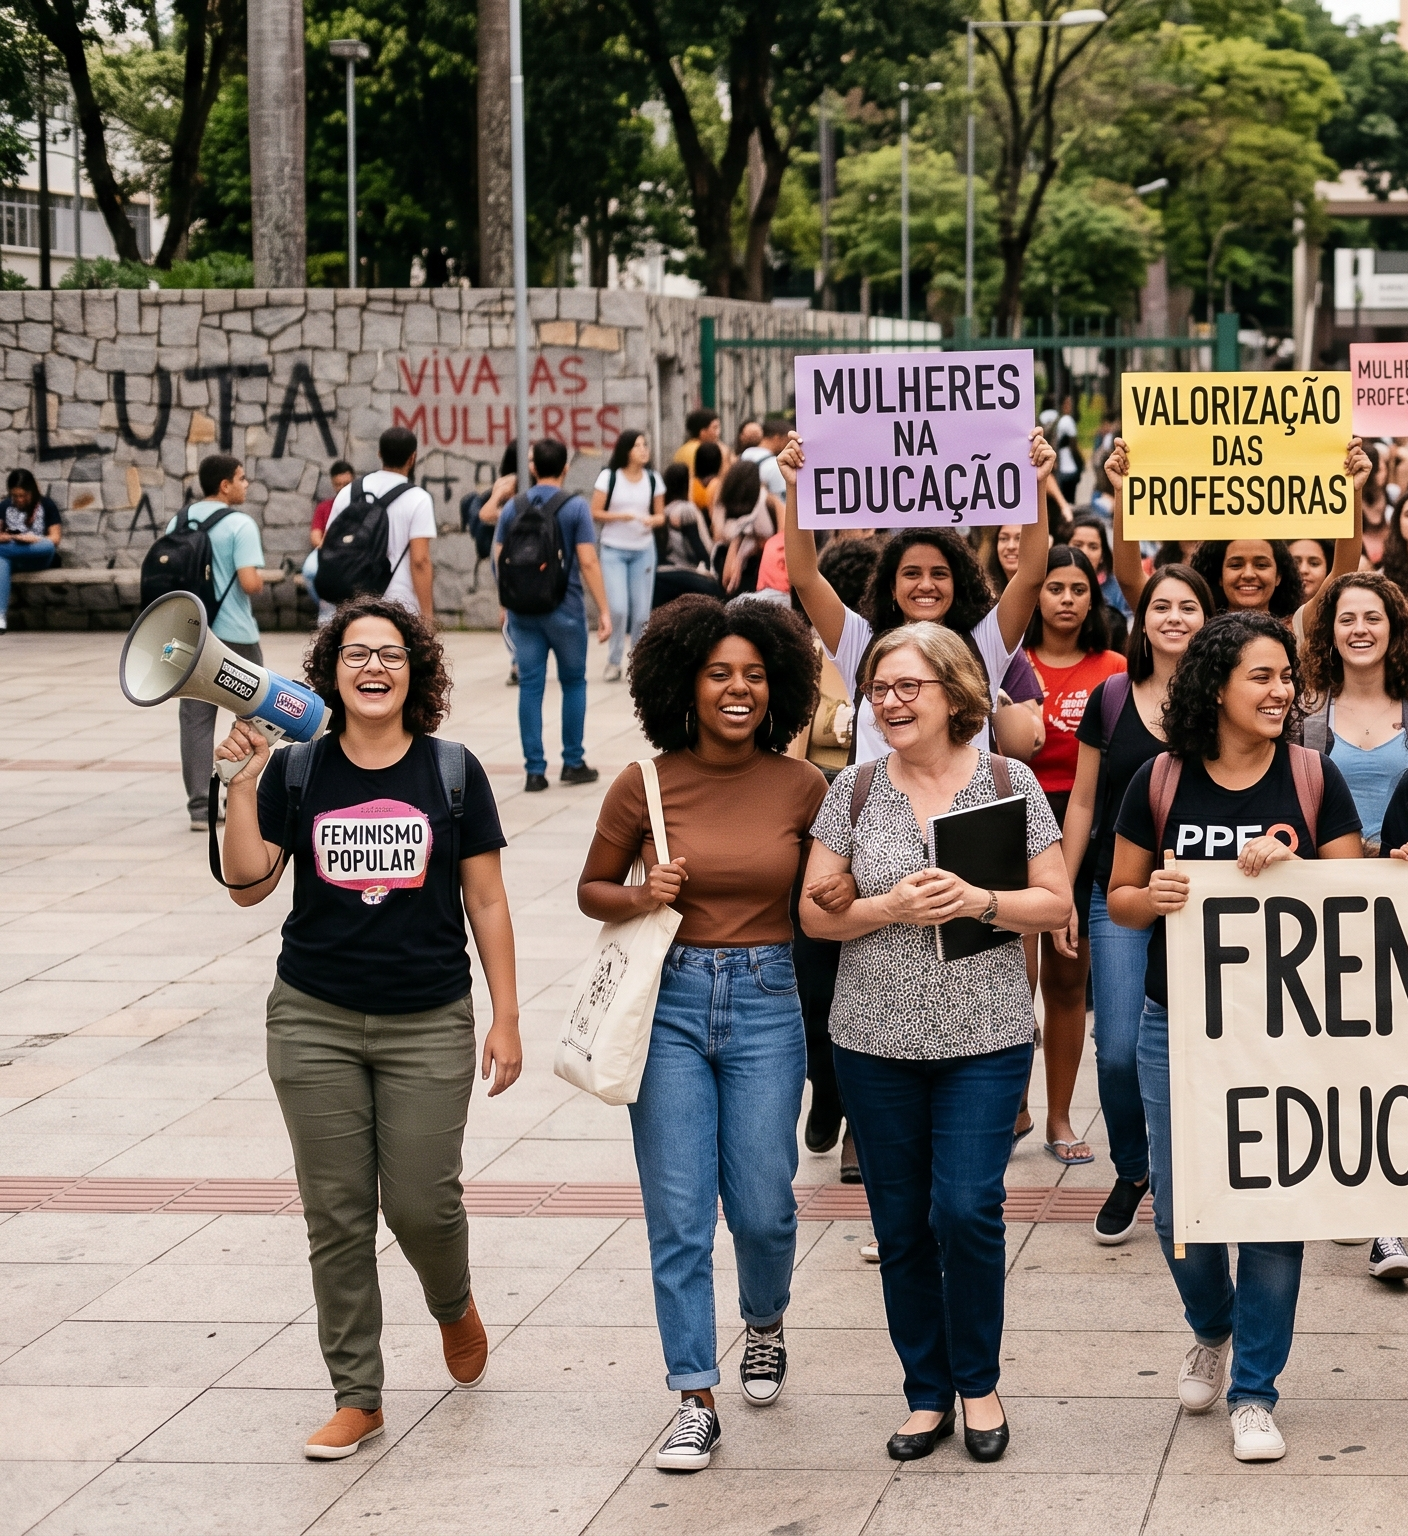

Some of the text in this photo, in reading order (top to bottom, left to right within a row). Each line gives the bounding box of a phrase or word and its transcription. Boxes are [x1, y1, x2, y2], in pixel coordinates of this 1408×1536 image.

[529, 355, 588, 396] AS
[813, 363, 1021, 415] MULHERES
[33, 361, 339, 463] LUTA
[1131, 376, 1342, 436] VALORIZAÇÃO
[893, 419, 939, 457] NA
[1212, 434, 1263, 466] DAS
[813, 453, 1021, 523] EDUCAÇÃO
[1128, 474, 1348, 516] PROFESSORAS
[321, 823, 423, 846] FEMINISMO
[327, 848, 416, 873] POPULAR
